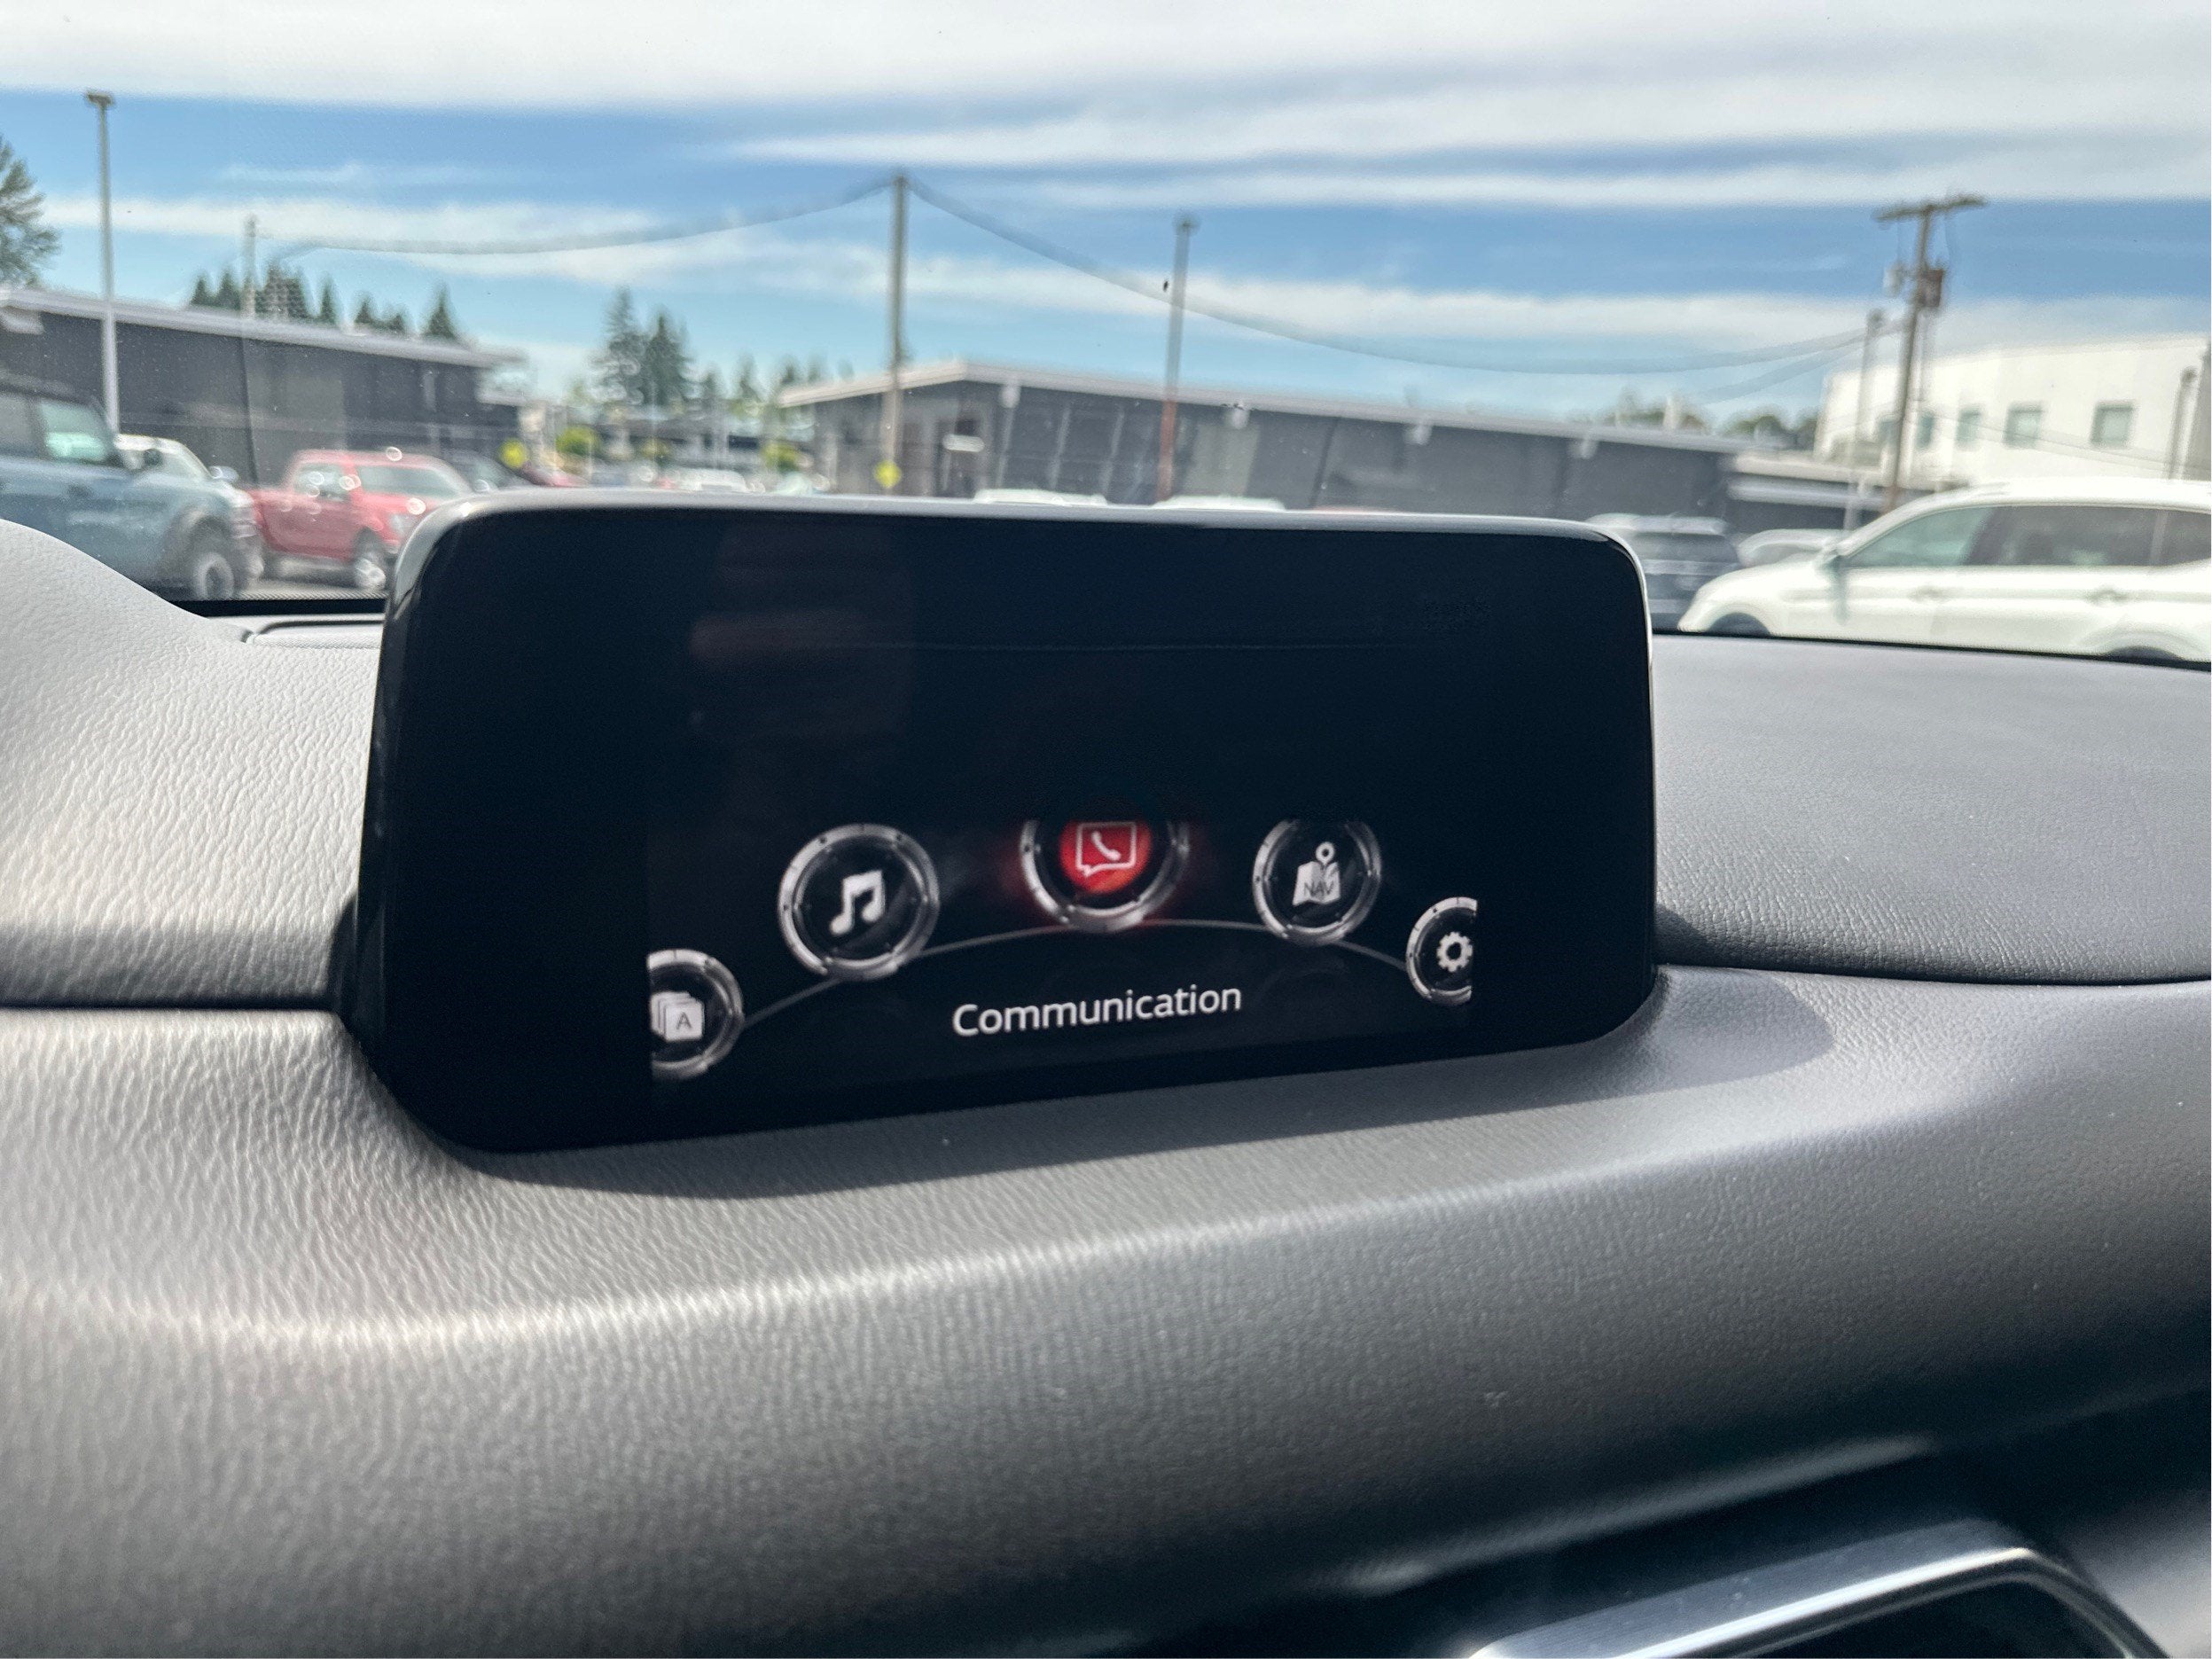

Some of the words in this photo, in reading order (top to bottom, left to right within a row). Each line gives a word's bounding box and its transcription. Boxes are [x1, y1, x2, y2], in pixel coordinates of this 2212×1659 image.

[1303, 880, 1335, 898] NAV
[952, 983, 1241, 1037] Communication
[676, 1011, 692, 1030] A
